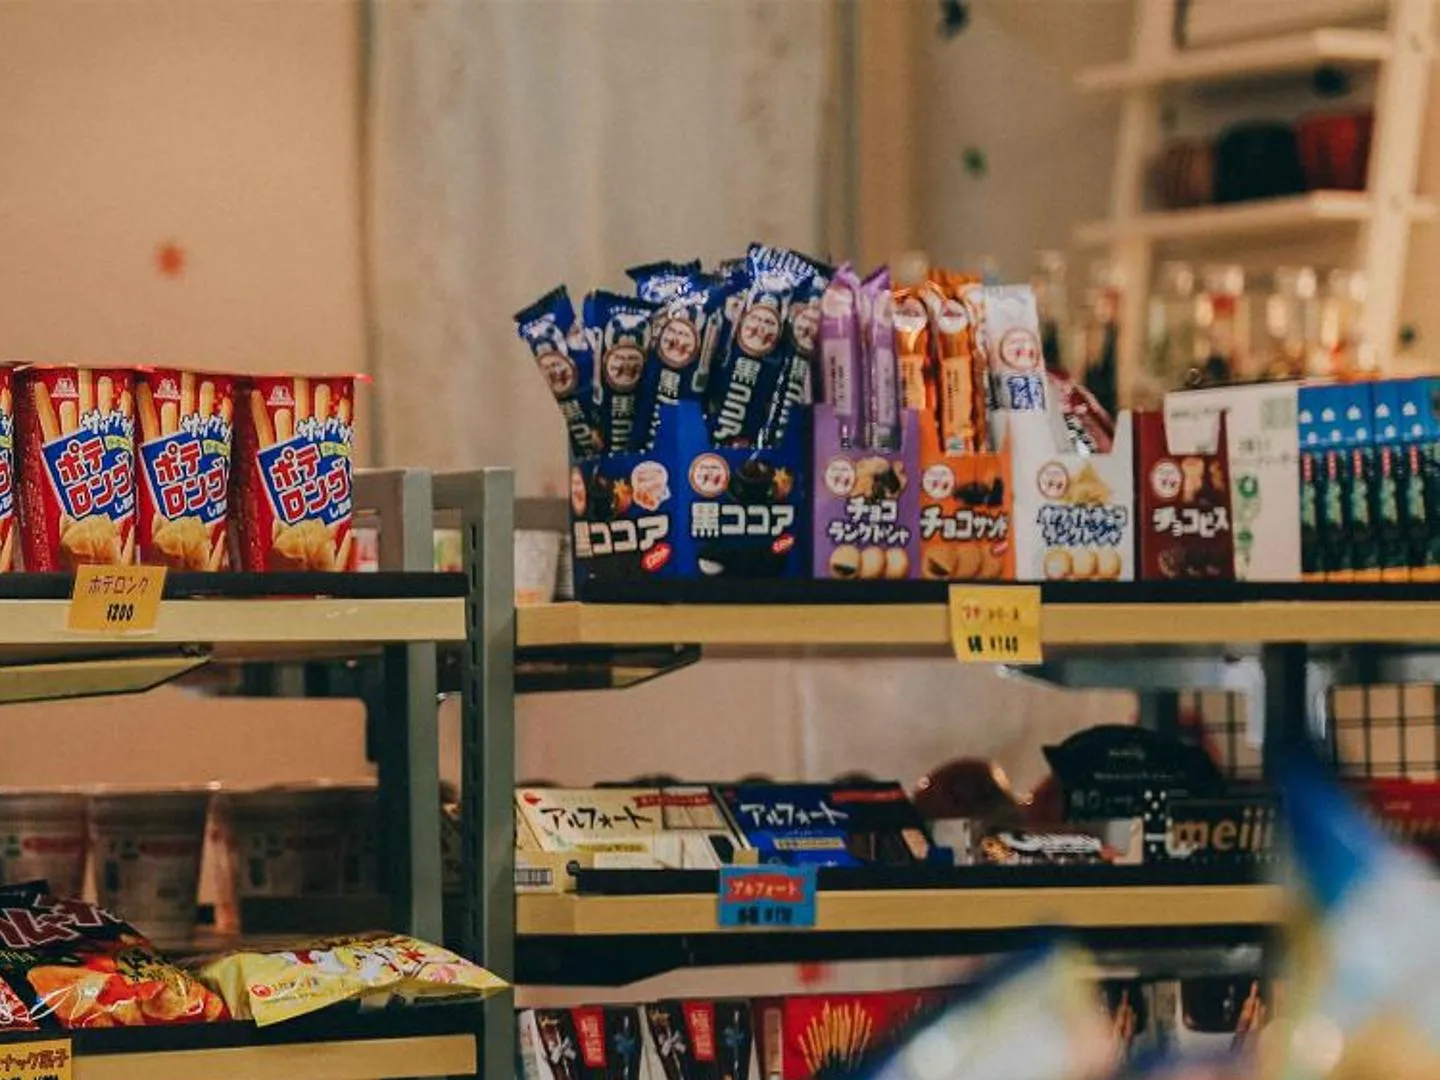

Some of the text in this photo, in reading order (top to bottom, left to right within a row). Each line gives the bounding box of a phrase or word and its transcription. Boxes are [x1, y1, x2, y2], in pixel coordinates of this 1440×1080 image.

[540, 804, 653, 831] アルフォート
[739, 801, 850, 830] アルフォート
